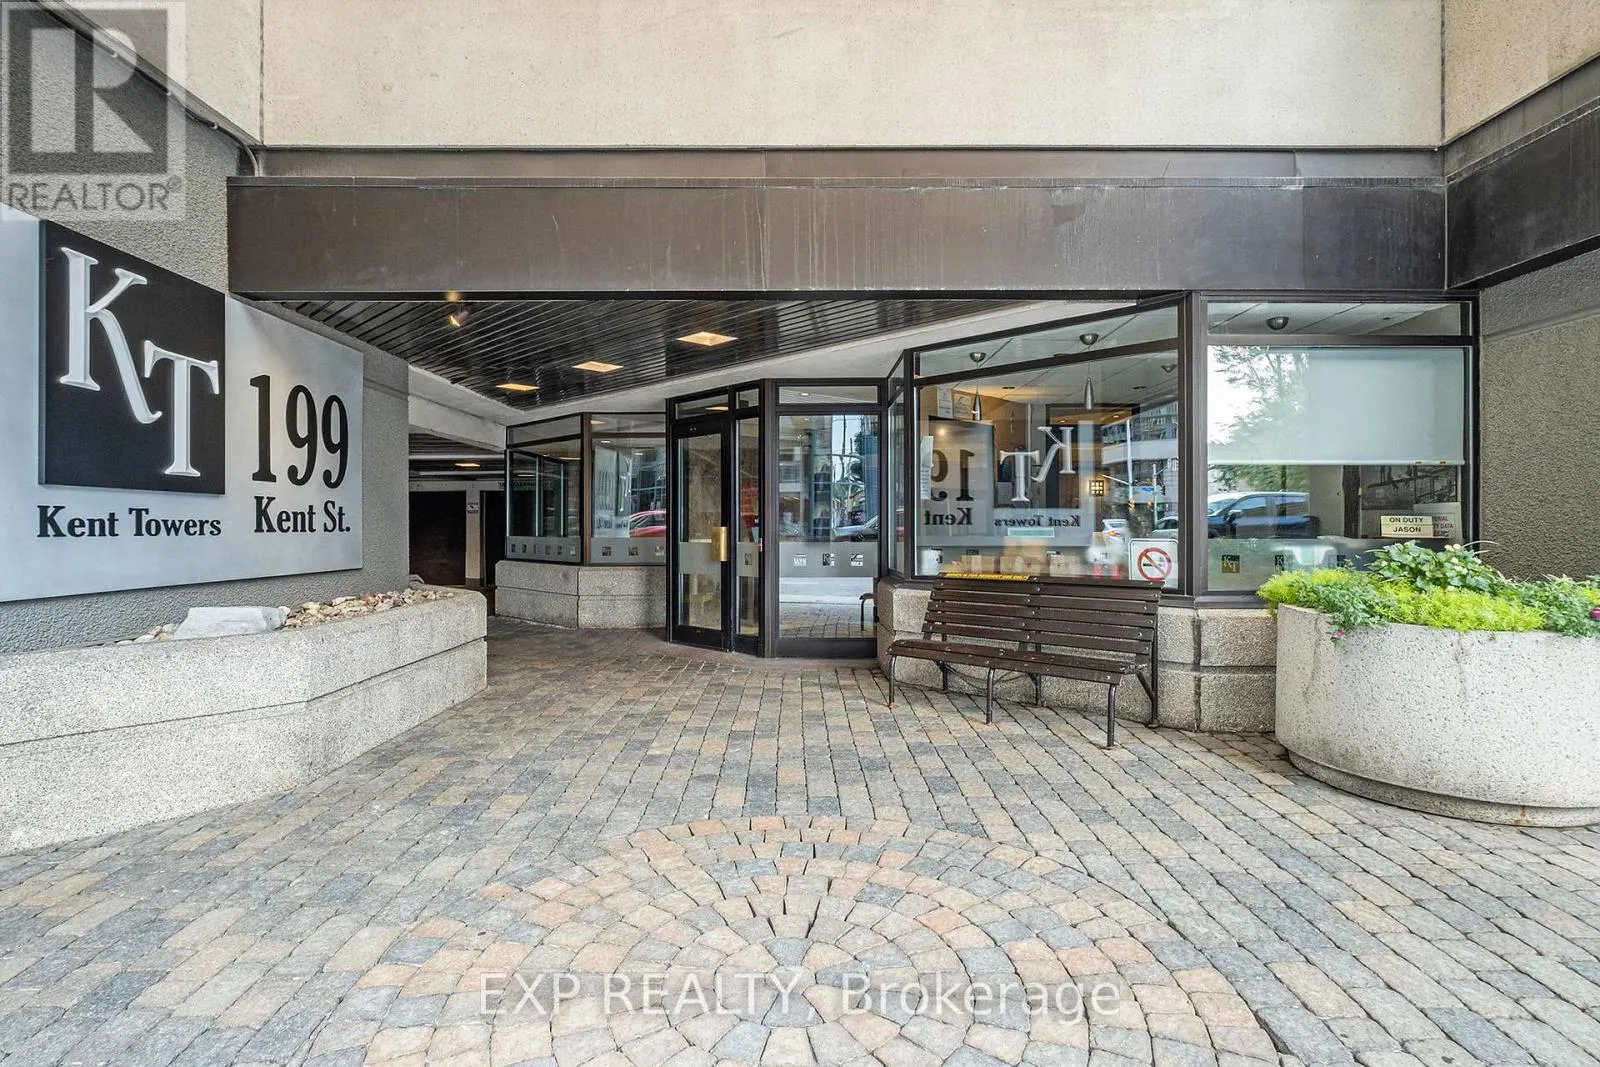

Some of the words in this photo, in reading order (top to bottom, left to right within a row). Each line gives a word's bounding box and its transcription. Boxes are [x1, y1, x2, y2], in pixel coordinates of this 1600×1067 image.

[250, 374, 349, 489] 199
[37, 505, 119, 538] Kent
[128, 508, 222, 537] Towers
[254, 496, 317, 534] Kent
[323, 500, 351, 533] St.
